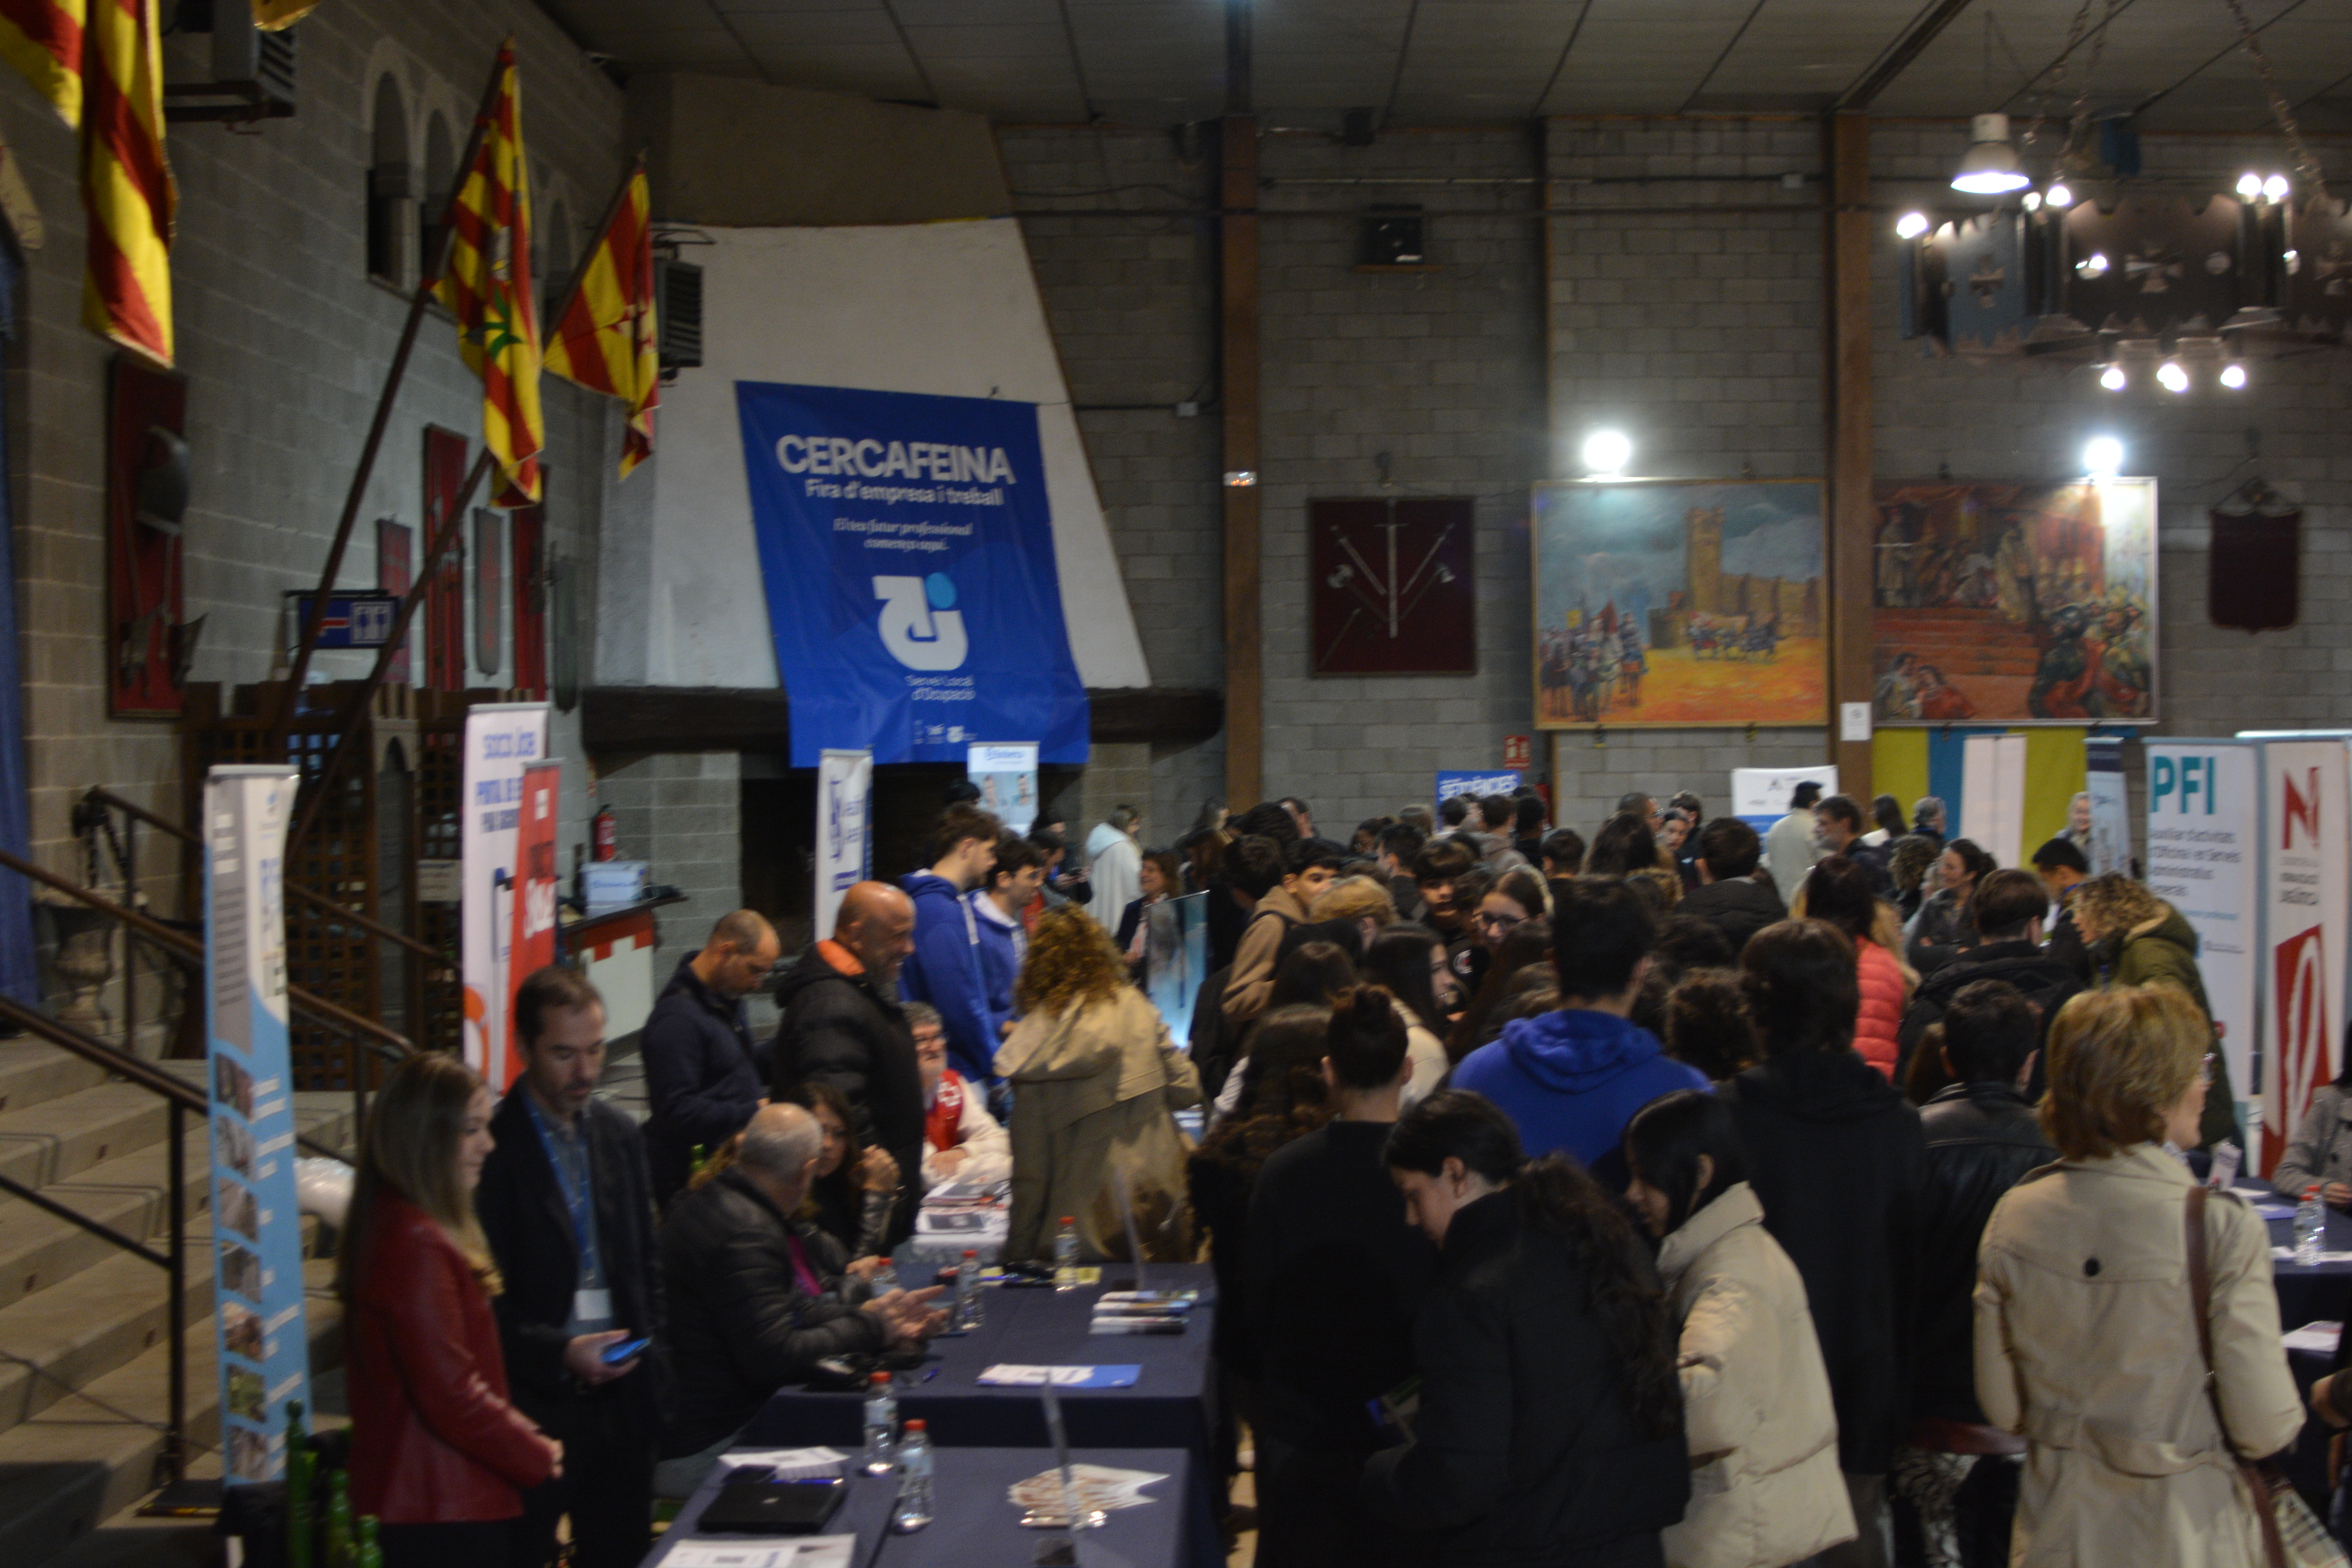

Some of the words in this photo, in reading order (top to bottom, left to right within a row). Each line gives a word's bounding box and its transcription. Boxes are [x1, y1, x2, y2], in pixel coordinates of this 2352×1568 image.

[775, 434, 1016, 485] CERCAFEINA
[805, 478, 842, 498] Fira
[844, 480, 936, 505] d'empresa
[936, 485, 946, 503] i
[946, 486, 1004, 506] treball
[868, 518, 900, 535] futur
[900, 520, 973, 537] professional
[2150, 756, 2216, 815] PFI
